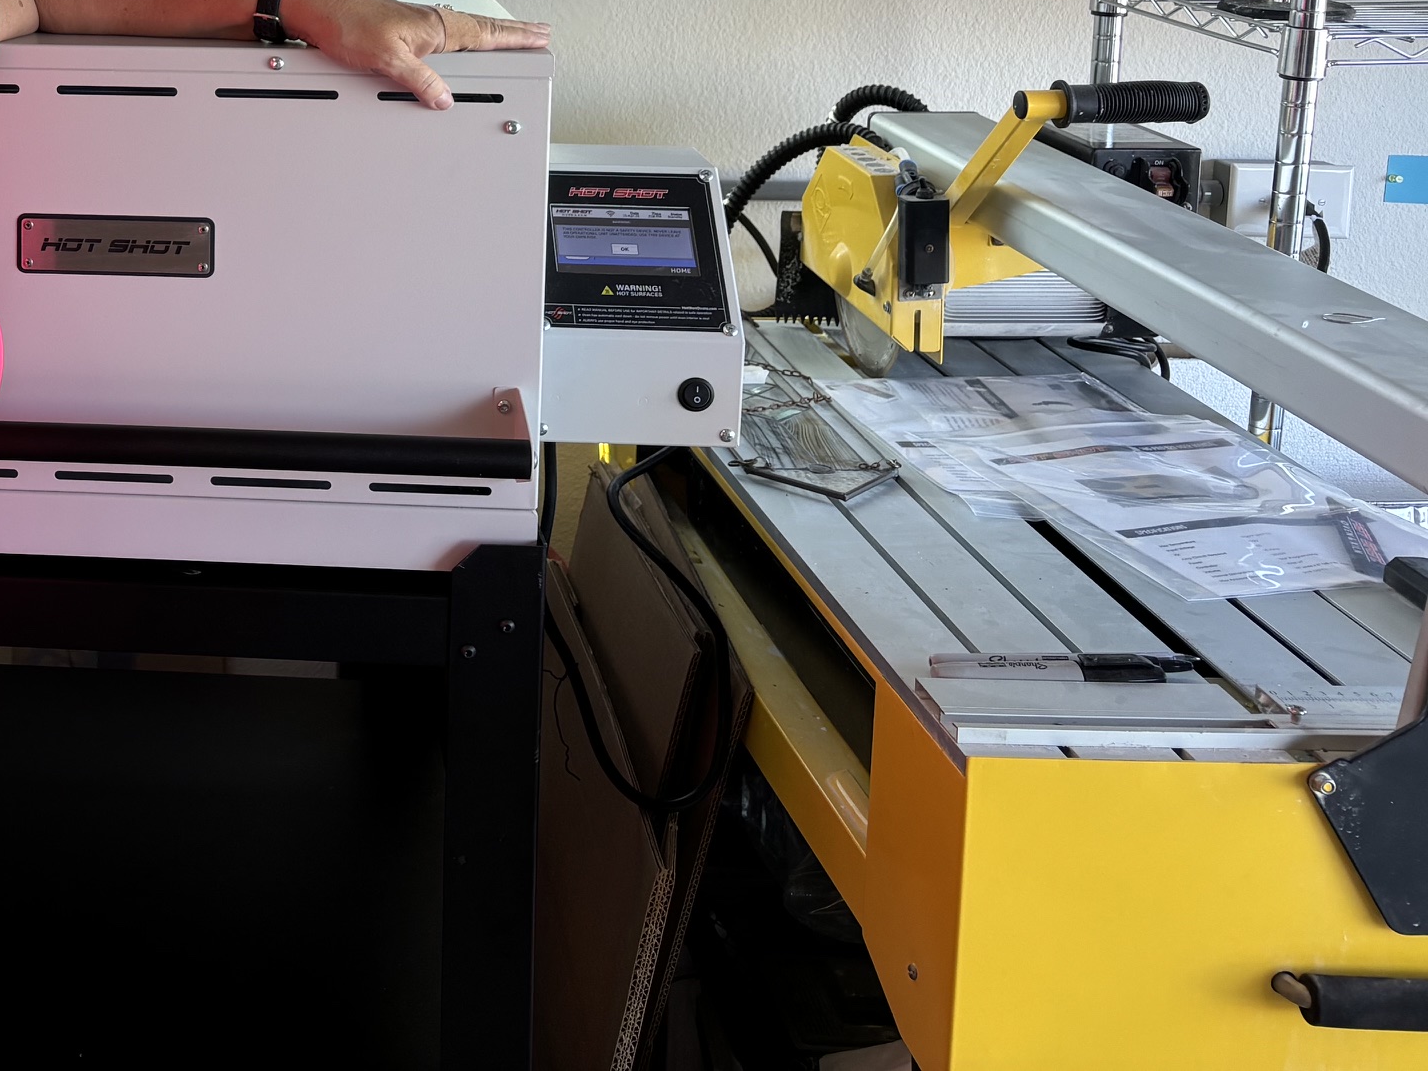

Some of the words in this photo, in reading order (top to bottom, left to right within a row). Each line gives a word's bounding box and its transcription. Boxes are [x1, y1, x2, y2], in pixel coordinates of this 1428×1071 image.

[568, 186, 611, 198] HOT
[612, 188, 669, 199] SHOT
[40, 237, 103, 253] HOT
[108, 239, 191, 255] SHOT
[615, 284, 662, 292] WARNING!
